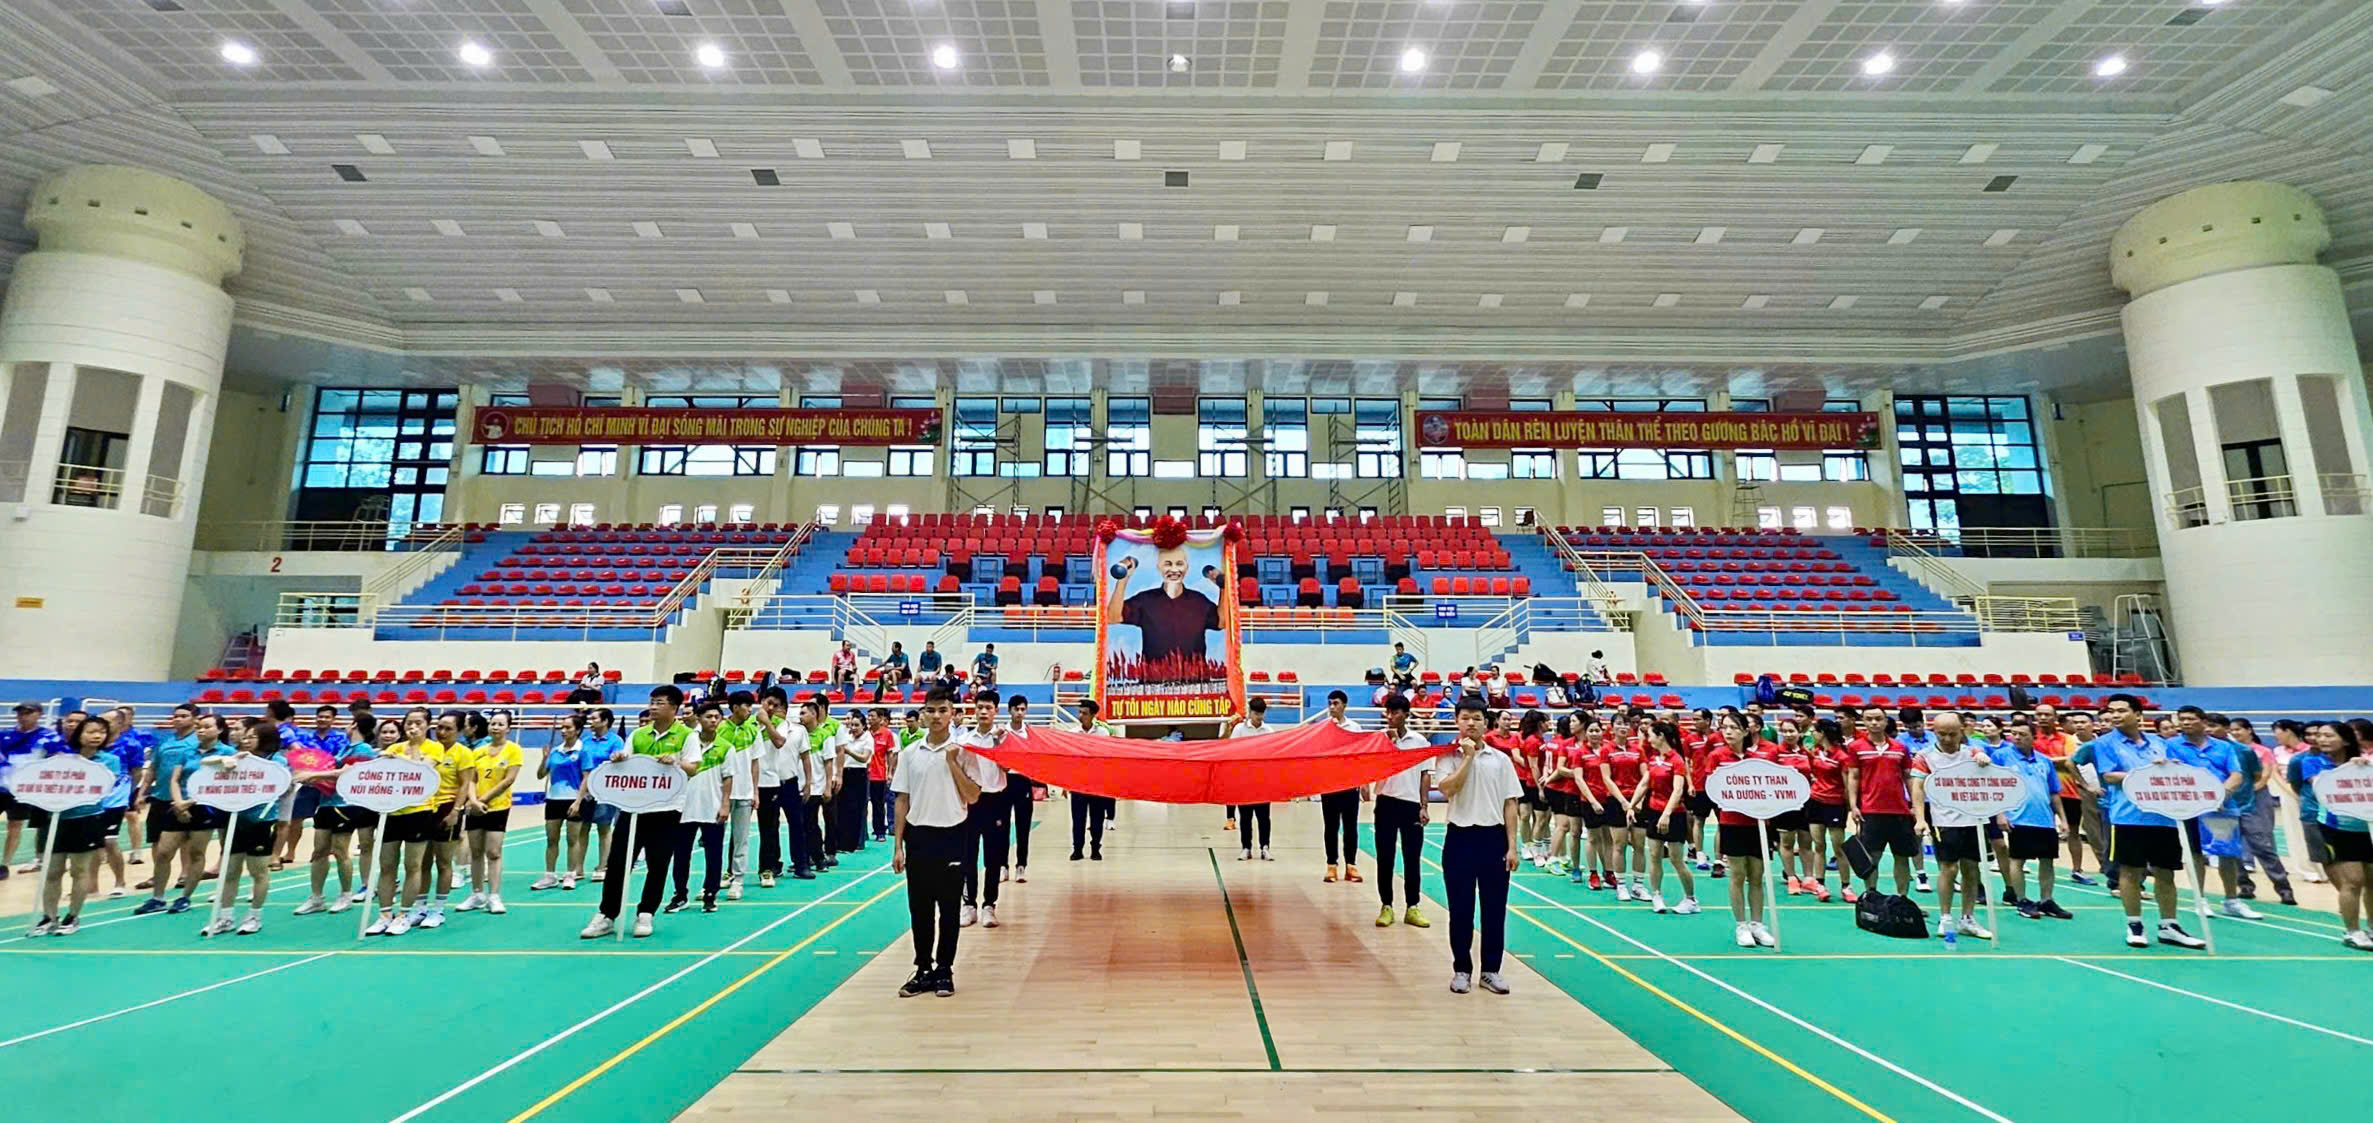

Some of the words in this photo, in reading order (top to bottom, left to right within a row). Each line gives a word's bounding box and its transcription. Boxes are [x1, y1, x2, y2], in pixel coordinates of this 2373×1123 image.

[514, 411, 537, 436] CHỦ
[540, 416, 565, 440] TỊCH
[567, 411, 583, 436] HỒ
[584, 413, 605, 437] CHÍ
[606, 417, 636, 437] MINH
[638, 414, 650, 437] VĨ
[651, 417, 670, 440] ĐẠI
[672, 411, 704, 437] SỐNG
[705, 414, 727, 437] MÃI
[729, 417, 766, 437] TRONG
[768, 415, 785, 441] SỰ
[785, 414, 825, 441] NGHIỆP
[828, 411, 850, 437] CỦA
[852, 414, 890, 437] CHÚNG
[893, 418, 905, 437] TA
[1454, 417, 1490, 442] TOÀN
[1492, 417, 1520, 442] DÂN
[1524, 418, 1550, 442] RÈN
[1554, 418, 1596, 445] LUYỆN
[1599, 418, 1634, 442] THÂN
[1637, 415, 1662, 442] THỂ
[1664, 423, 1699, 443] THEO
[1701, 421, 1748, 443] GƯƠNG
[1751, 419, 1777, 443] BÁC
[1781, 417, 1799, 443] HỒ
[1802, 419, 1815, 443] VĨ
[1818, 423, 1842, 446] ĐẠI
[271, 556, 282, 573] 2
[1111, 700, 1124, 719] TỰ
[1125, 697, 1139, 716] TÔI
[1141, 697, 1165, 717] NGÀY
[1166, 696, 1186, 717] NÀO
[1187, 696, 1212, 716] CŨNG
[1214, 695, 1232, 718] TẬP
[358, 770, 383, 781] CÔNG
[385, 771, 397, 781] TY
[398, 771, 422, 782] THAN
[484, 768, 492, 779] 2
[1726, 774, 1750, 786] CÔNG
[1752, 775, 1762, 786] TY
[1765, 775, 1788, 786] THAN
[350, 783, 366, 794] NÚI
[368, 782, 393, 795] HỒNG
[402, 785, 424, 796] VVMI
[604, 775, 647, 792] TRỌNG
[651, 773, 672, 790] TÀI
[1721, 790, 1734, 800] NA
[1736, 789, 1767, 800] DƯƠNG
[1774, 790, 1797, 800] VVMI
